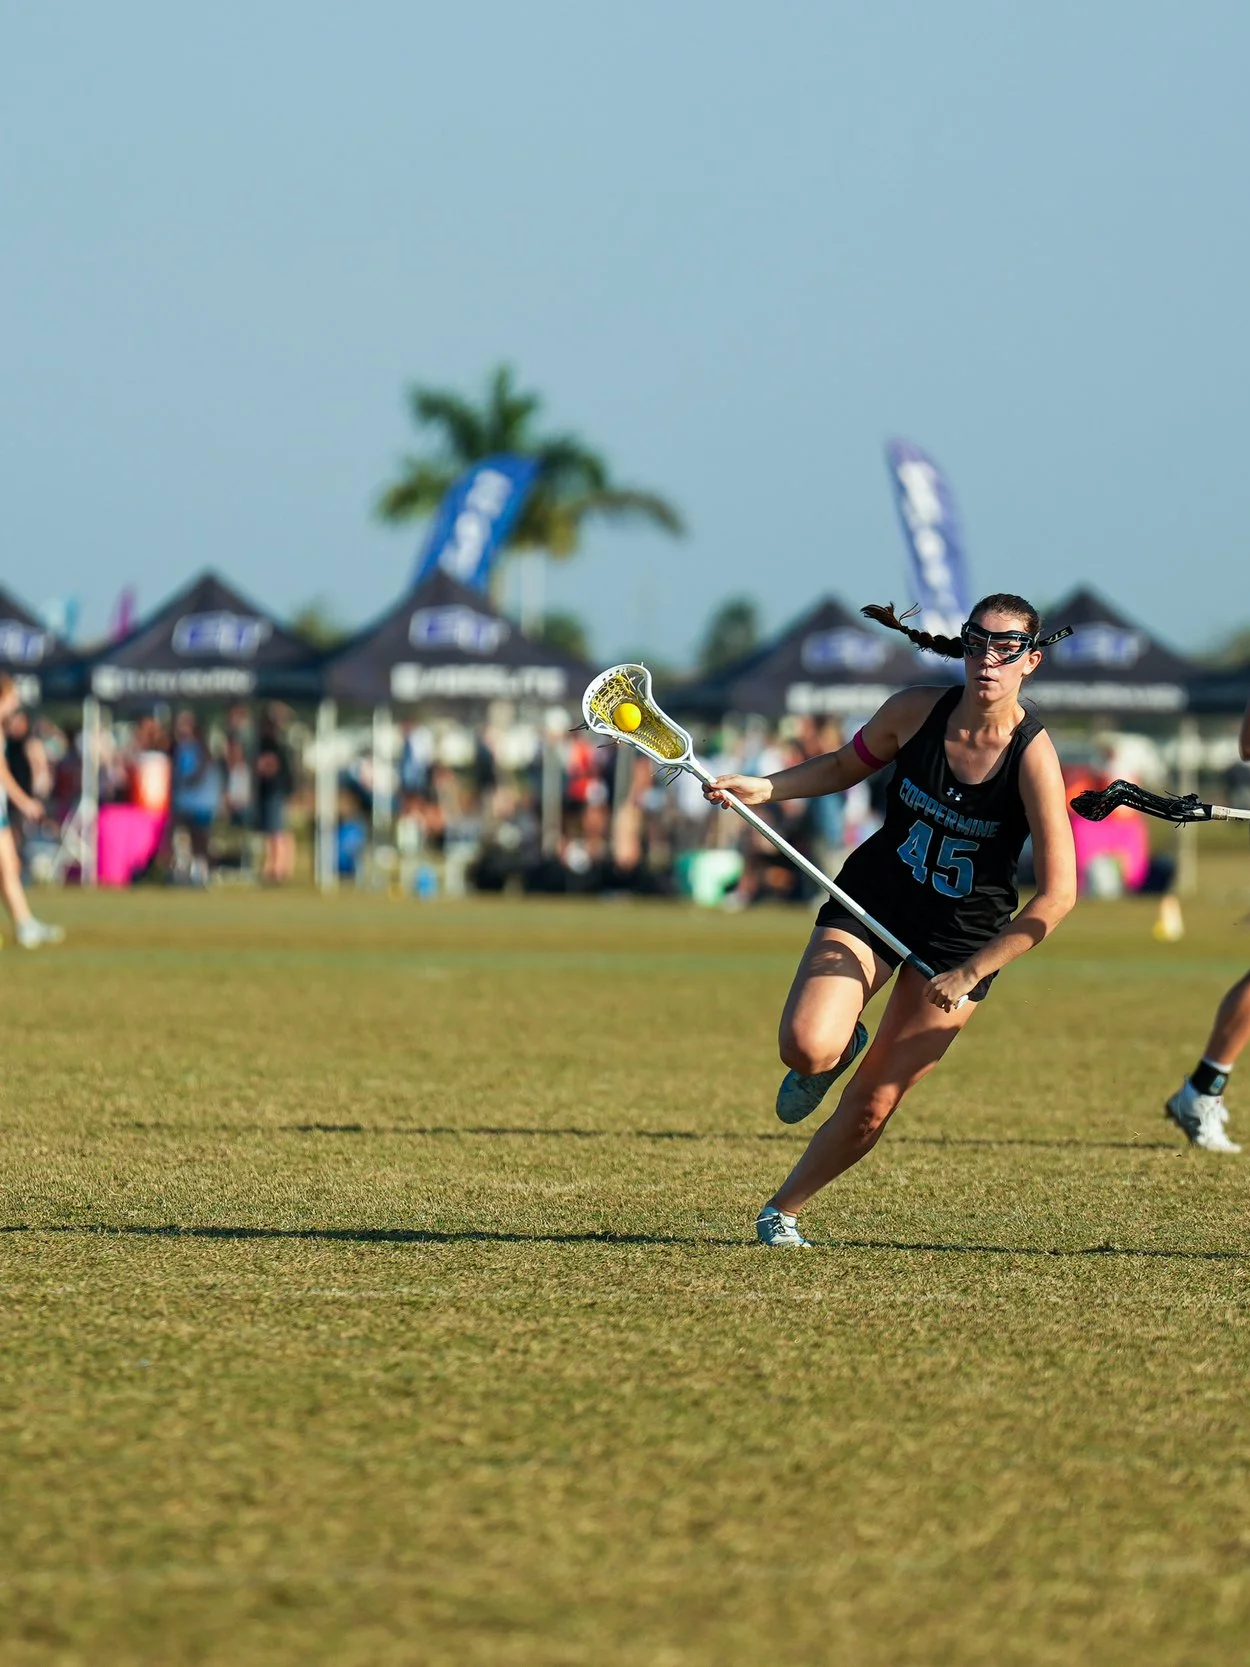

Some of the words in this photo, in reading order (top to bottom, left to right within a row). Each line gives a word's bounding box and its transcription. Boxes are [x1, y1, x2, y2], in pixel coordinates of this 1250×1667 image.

[1047, 629, 1070, 645] STX
[899, 778, 1001, 838] COPPERMINE
[897, 819, 980, 898] 45
